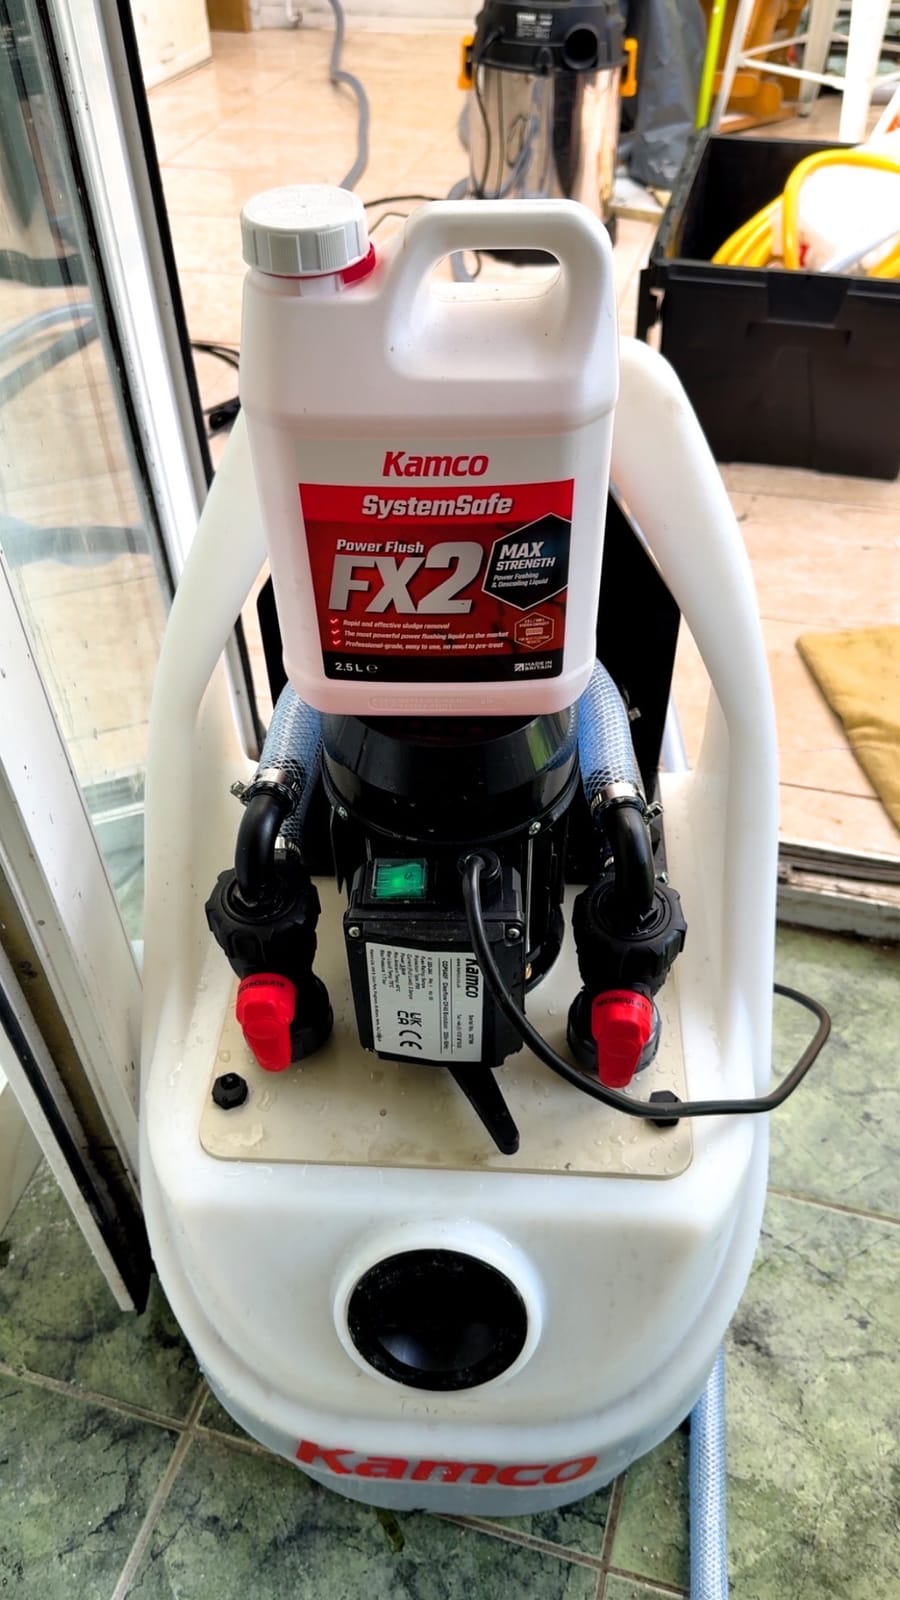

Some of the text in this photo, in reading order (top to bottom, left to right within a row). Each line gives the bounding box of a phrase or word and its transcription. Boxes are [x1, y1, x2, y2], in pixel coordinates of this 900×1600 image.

[382, 451, 489, 477] Kamco
[361, 493, 513, 519] SystemSafe
[336, 539, 424, 554] Power Flush
[499, 541, 544, 560] MAX
[495, 556, 555, 571] STRENGTH
[328, 540, 485, 615] FX2
[498, 580, 529, 588] Descaling
[529, 578, 549, 586] Liquid
[342, 619, 361, 627] Rapid
[373, 621, 402, 629] effective
[402, 622, 424, 630] sludge
[424, 622, 450, 630] removal
[335, 662, 354, 673] 2.5
[355, 663, 364, 673] L
[466, 958, 480, 998] Kamco
[295, 1439, 599, 1486] Kamco
